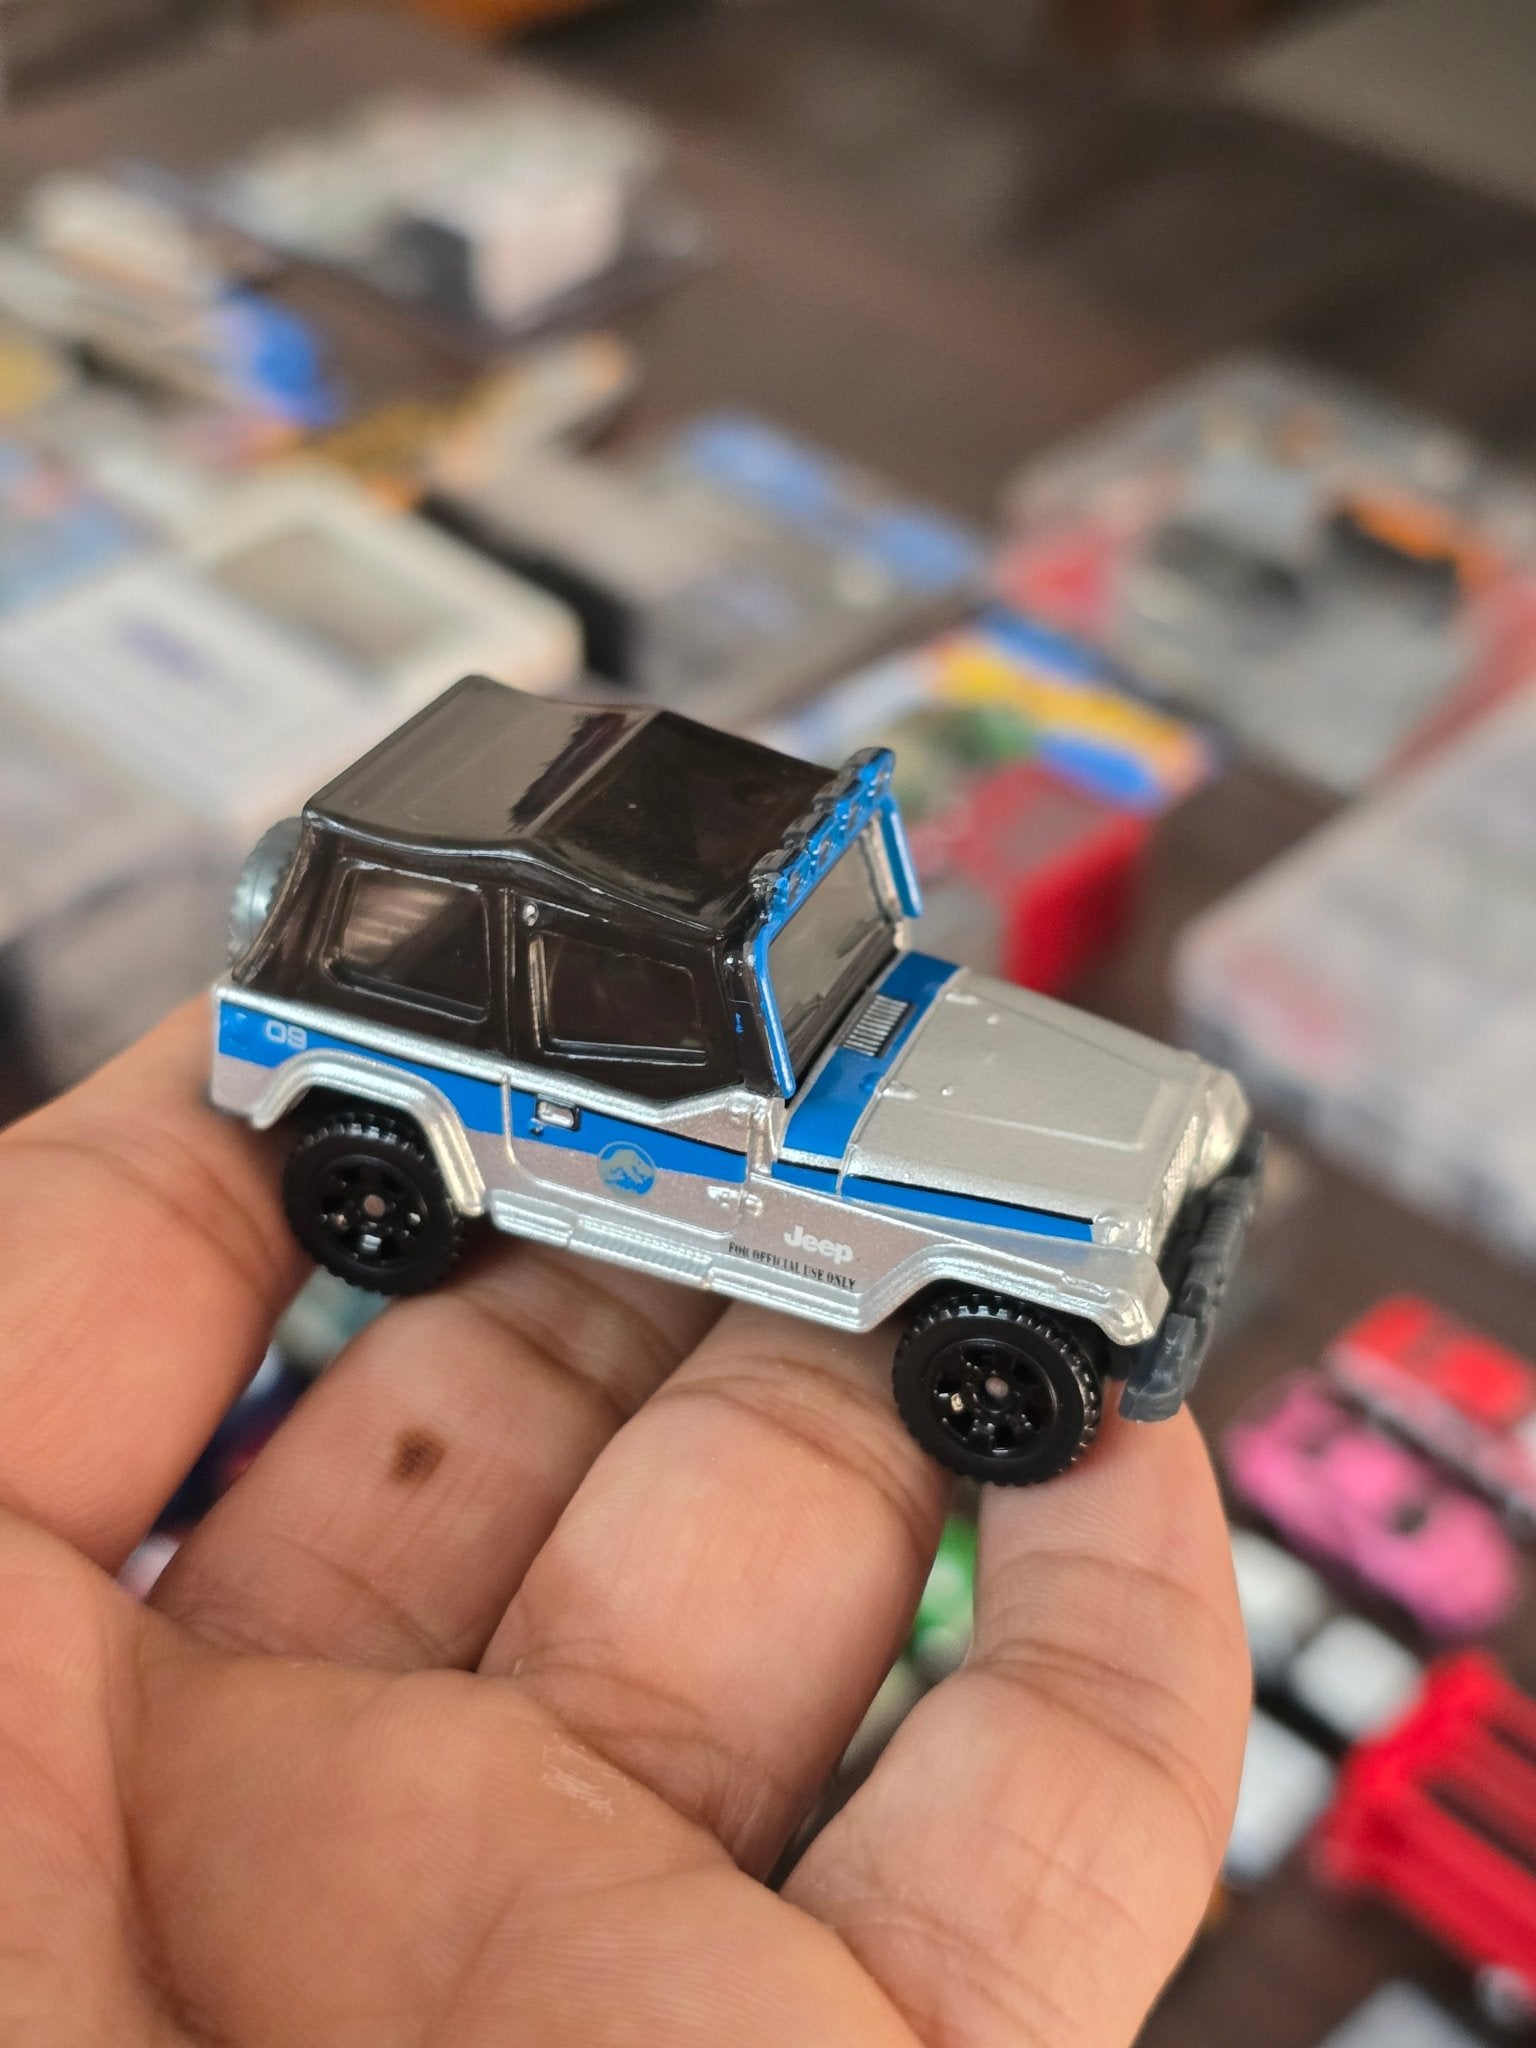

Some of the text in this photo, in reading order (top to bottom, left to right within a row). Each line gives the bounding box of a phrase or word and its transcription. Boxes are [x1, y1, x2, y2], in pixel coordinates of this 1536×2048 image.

[728, 1241, 857, 1290] FOR OFFICIAL USE ONLY
[783, 1224, 854, 1264] Jeep
